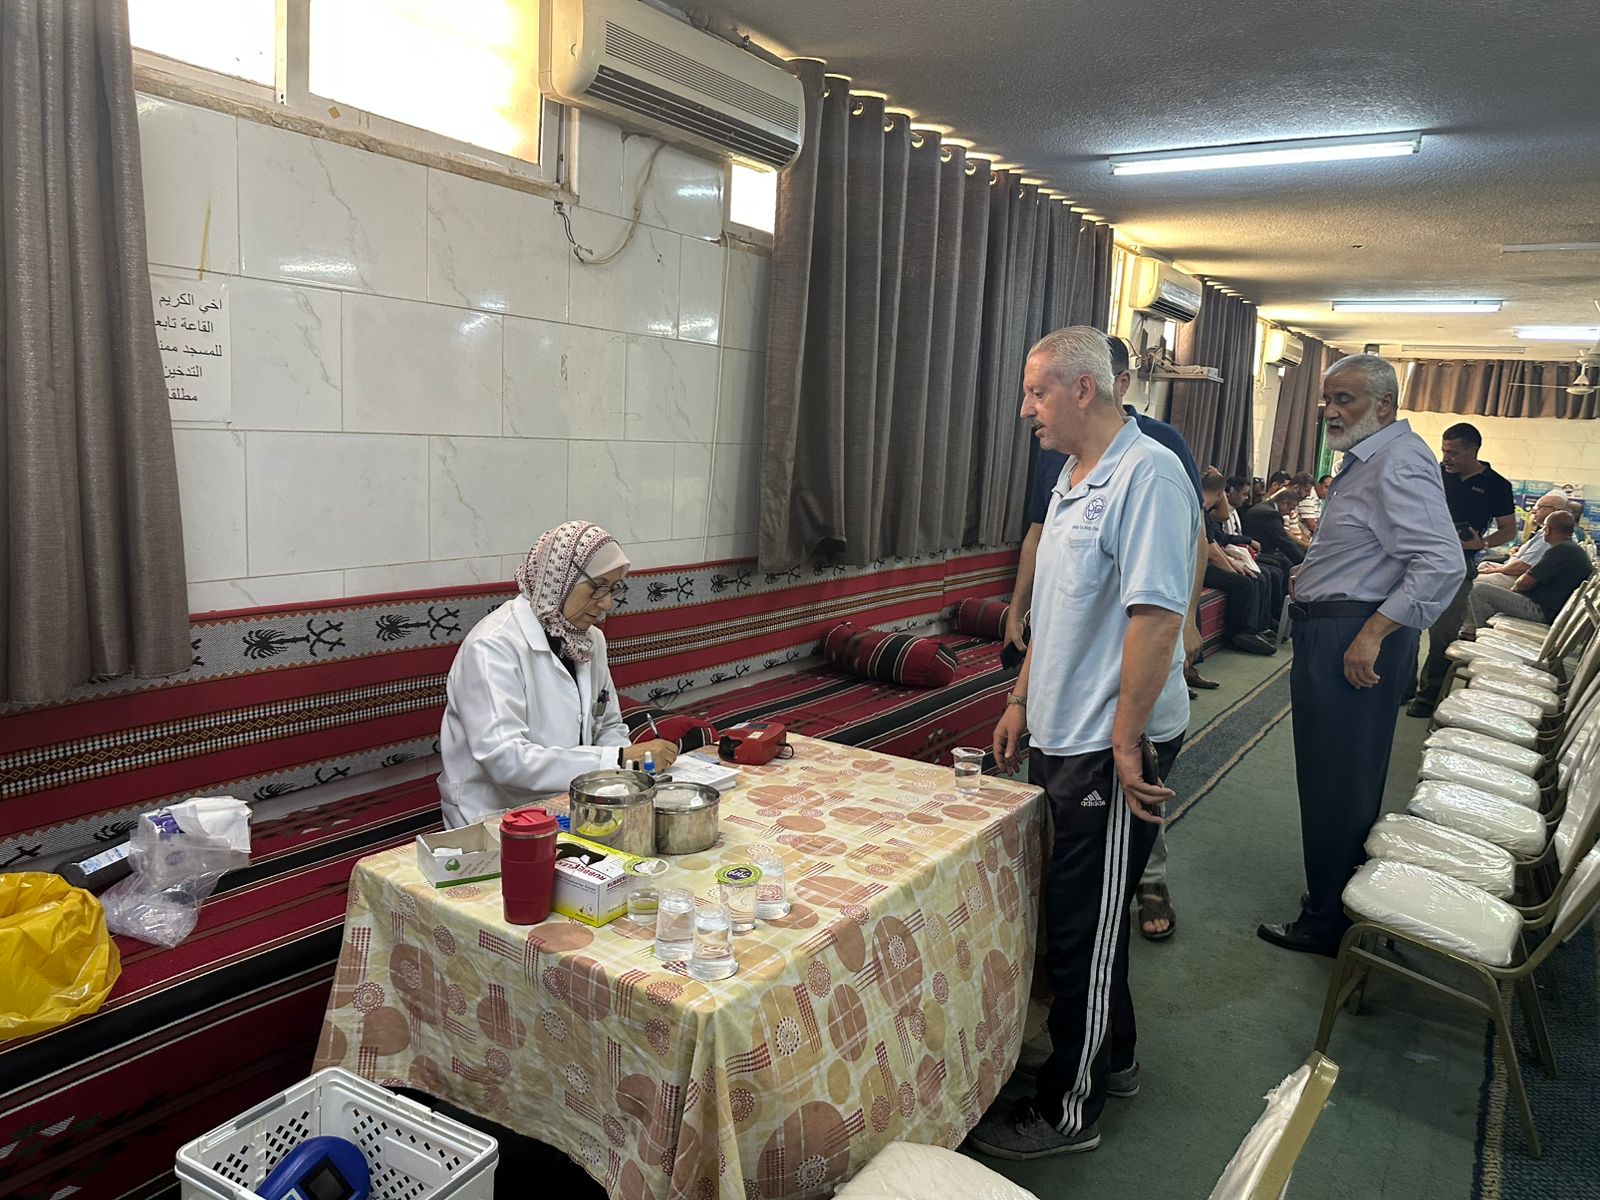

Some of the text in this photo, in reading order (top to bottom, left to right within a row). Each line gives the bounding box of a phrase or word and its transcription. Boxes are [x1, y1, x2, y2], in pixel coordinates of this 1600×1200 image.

[158, 293, 222, 313] اخي الكريم
[154, 315, 213, 333] القاعة تابع
[158, 339, 222, 357] للمسجد ممن
